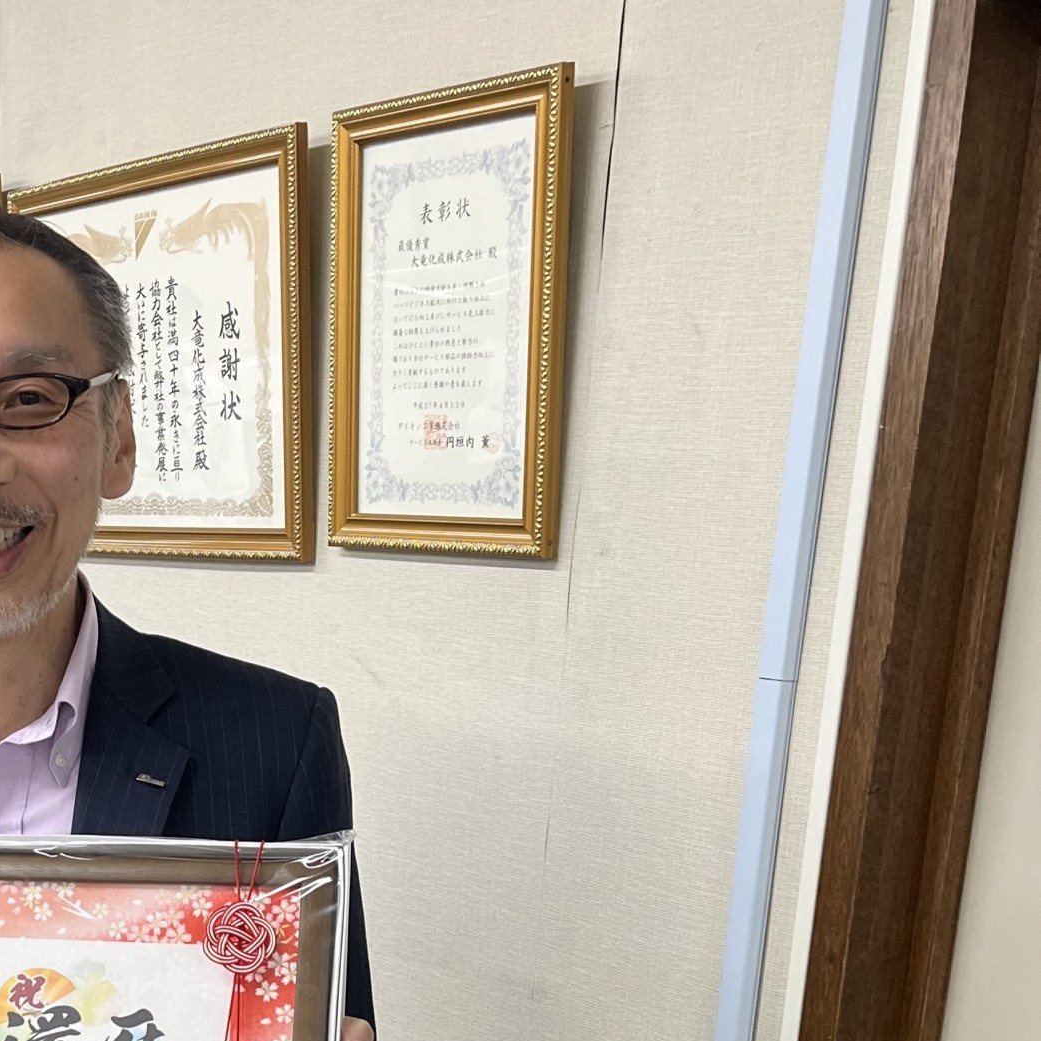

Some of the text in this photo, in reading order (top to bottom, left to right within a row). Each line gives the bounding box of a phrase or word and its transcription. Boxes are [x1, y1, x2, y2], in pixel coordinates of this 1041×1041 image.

[134, 209, 158, 220] DAIKIN
[419, 197, 471, 225] 表彰状
[399, 237, 430, 252] 最優秀賞
[411, 246, 497, 267] 大竜化成株式会社 殿
[218, 301, 242, 421] 感謝状
[191, 309, 210, 471] 大竜化成株式会社 殿
[9, 973, 46, 1010] 祝
